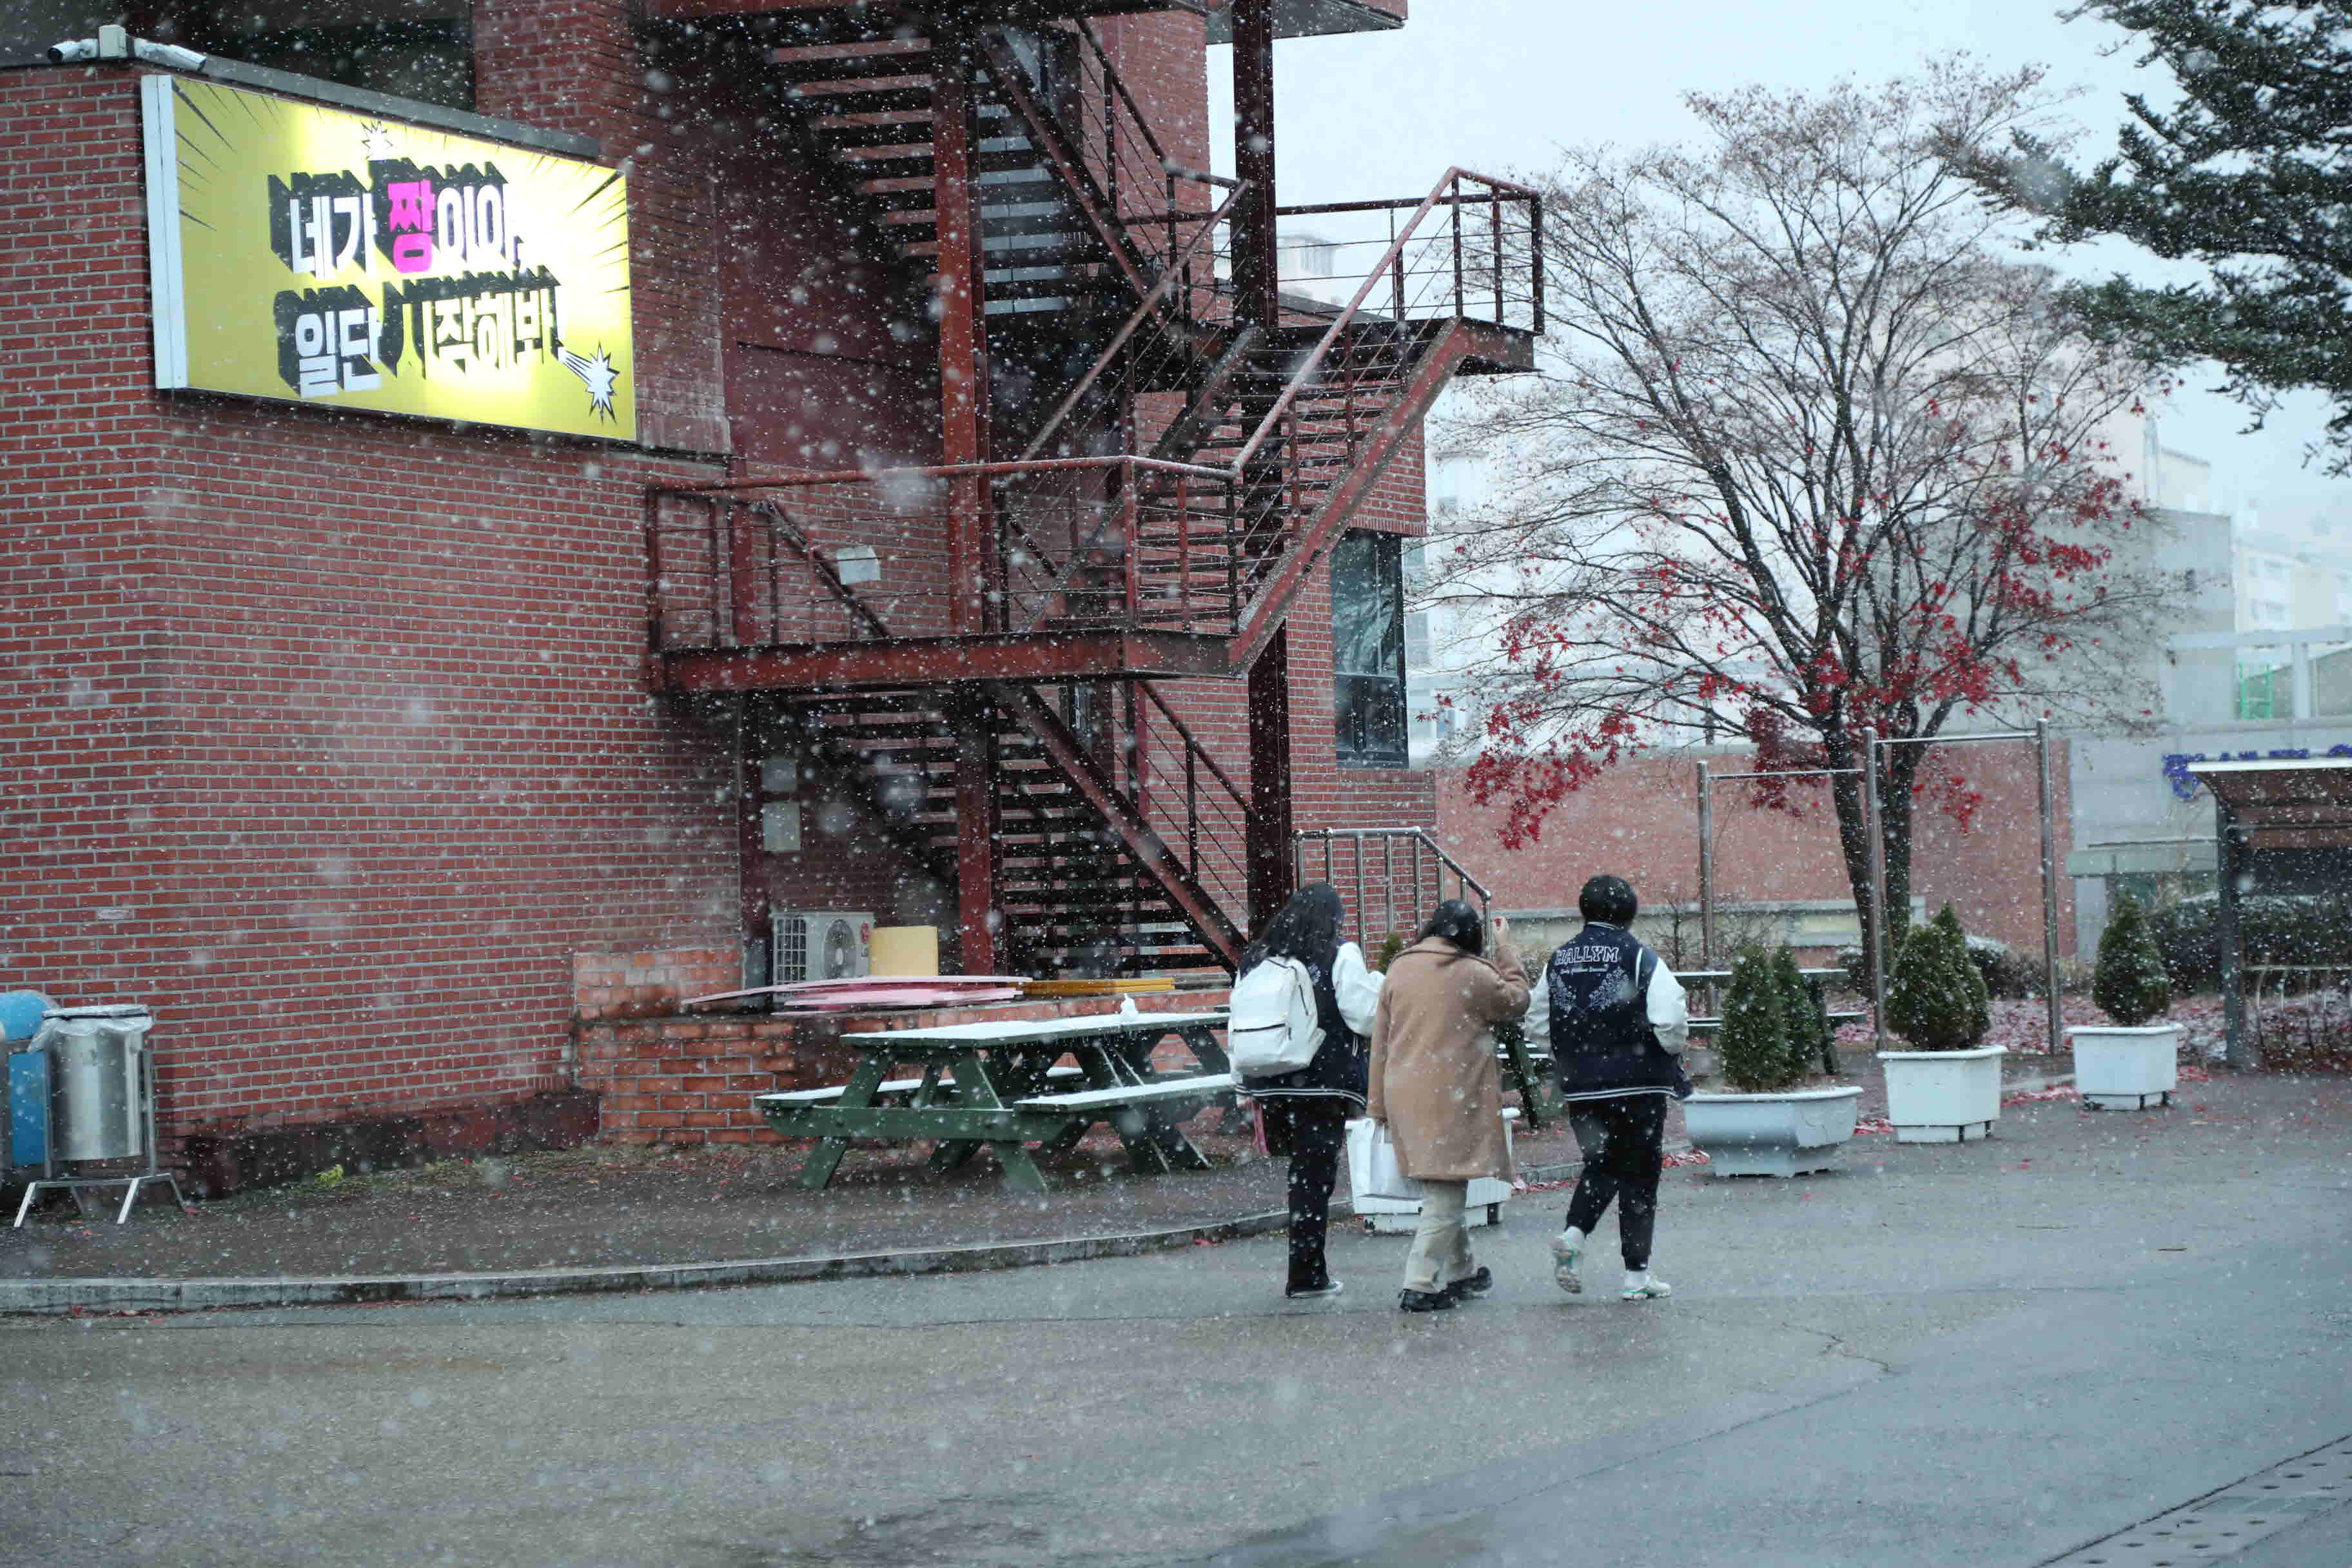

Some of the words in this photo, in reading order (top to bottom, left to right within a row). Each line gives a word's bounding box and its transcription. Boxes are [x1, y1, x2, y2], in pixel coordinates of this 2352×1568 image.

[279, 181, 377, 280] 네가
[282, 294, 383, 398] 일단
[1554, 945, 1620, 966] HALLYM
